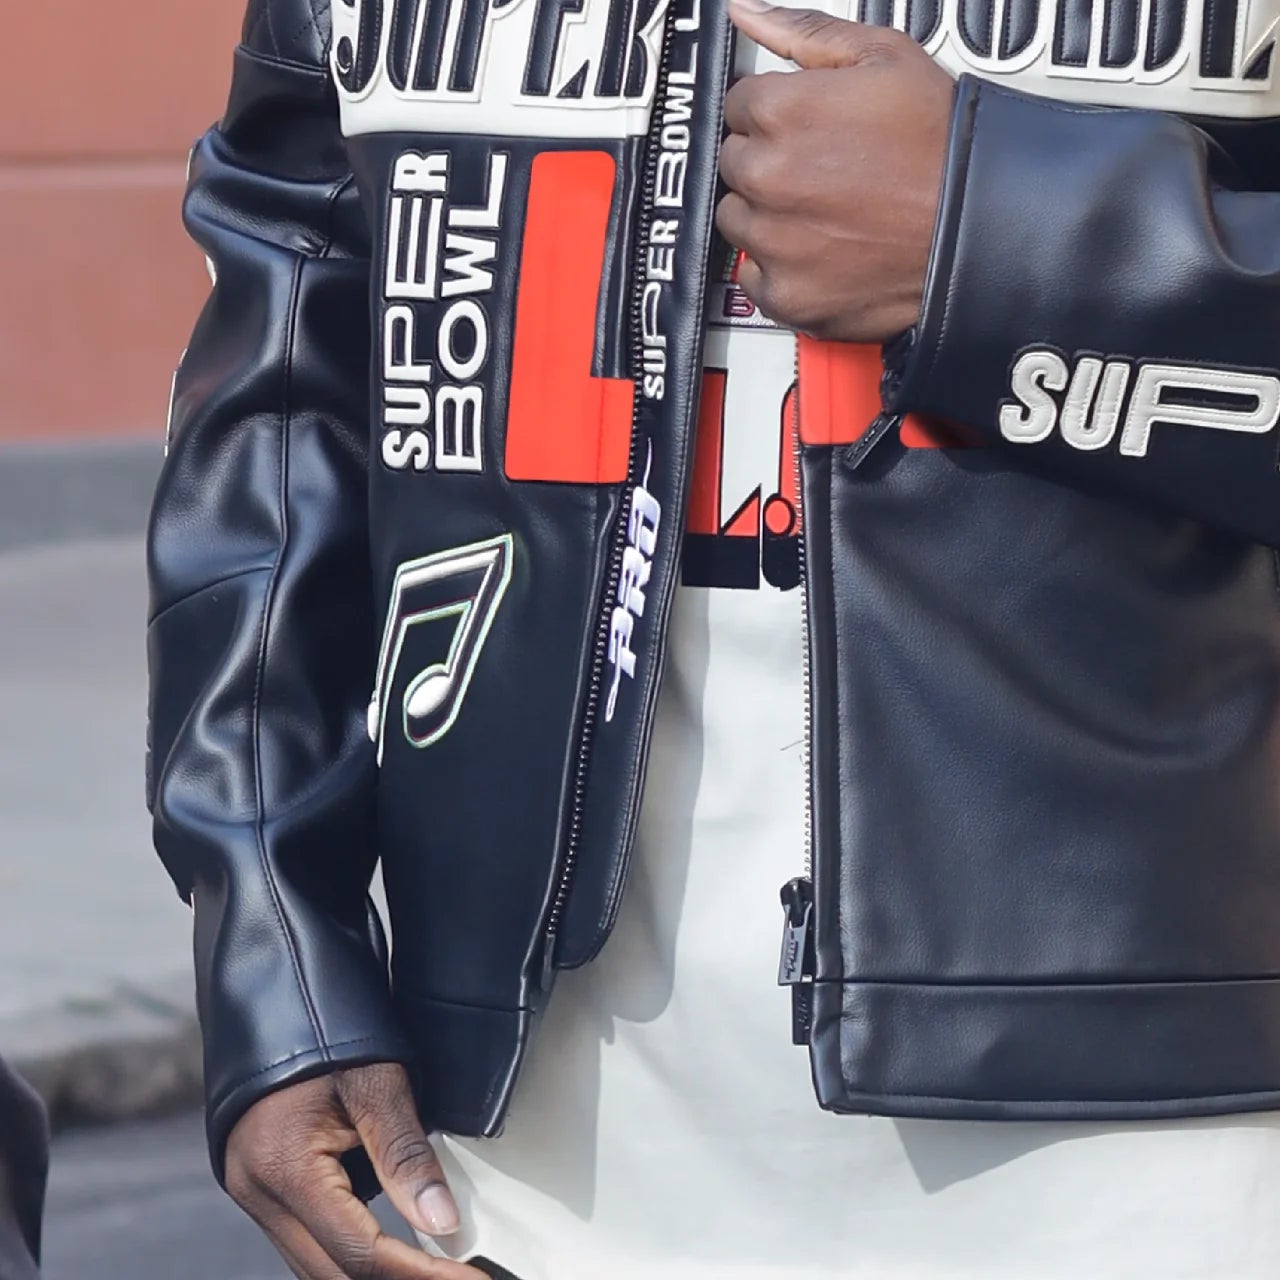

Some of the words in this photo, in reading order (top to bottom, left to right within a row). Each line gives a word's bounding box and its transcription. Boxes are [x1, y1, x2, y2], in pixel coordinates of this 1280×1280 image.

[655, 41, 698, 208] BOWL
[381, 151, 449, 471] SUPER
[434, 153, 507, 473] BOWL
[643, 219, 680, 401] SUPER
